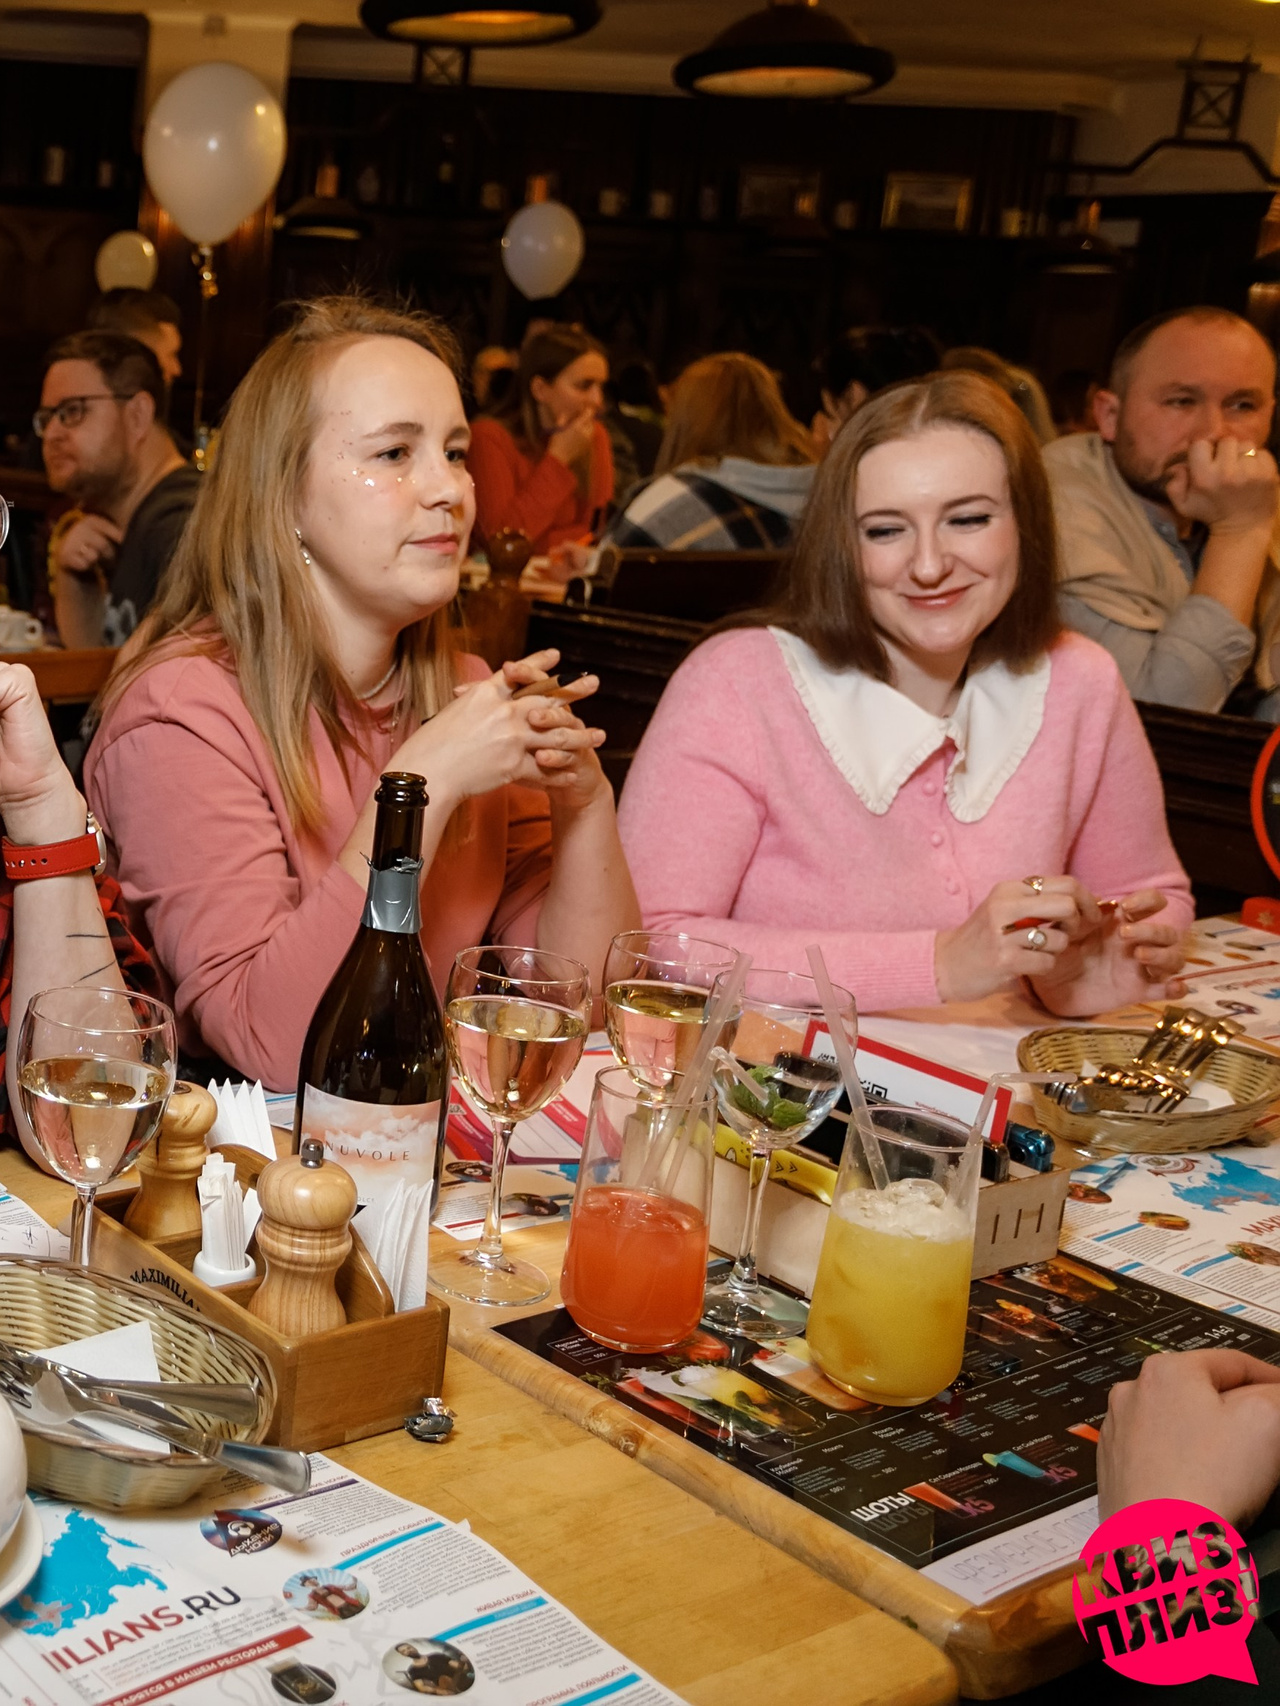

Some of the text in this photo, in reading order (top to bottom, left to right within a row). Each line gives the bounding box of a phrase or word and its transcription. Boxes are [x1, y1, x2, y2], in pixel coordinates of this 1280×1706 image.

[324, 1140, 411, 1161] NUVOLE
[129, 1267, 201, 1312] MAXIMILIA
[850, 1492, 916, 1522] ШОТЫ
[219, 1640, 279, 1668] РЕСТОРАНЕ
